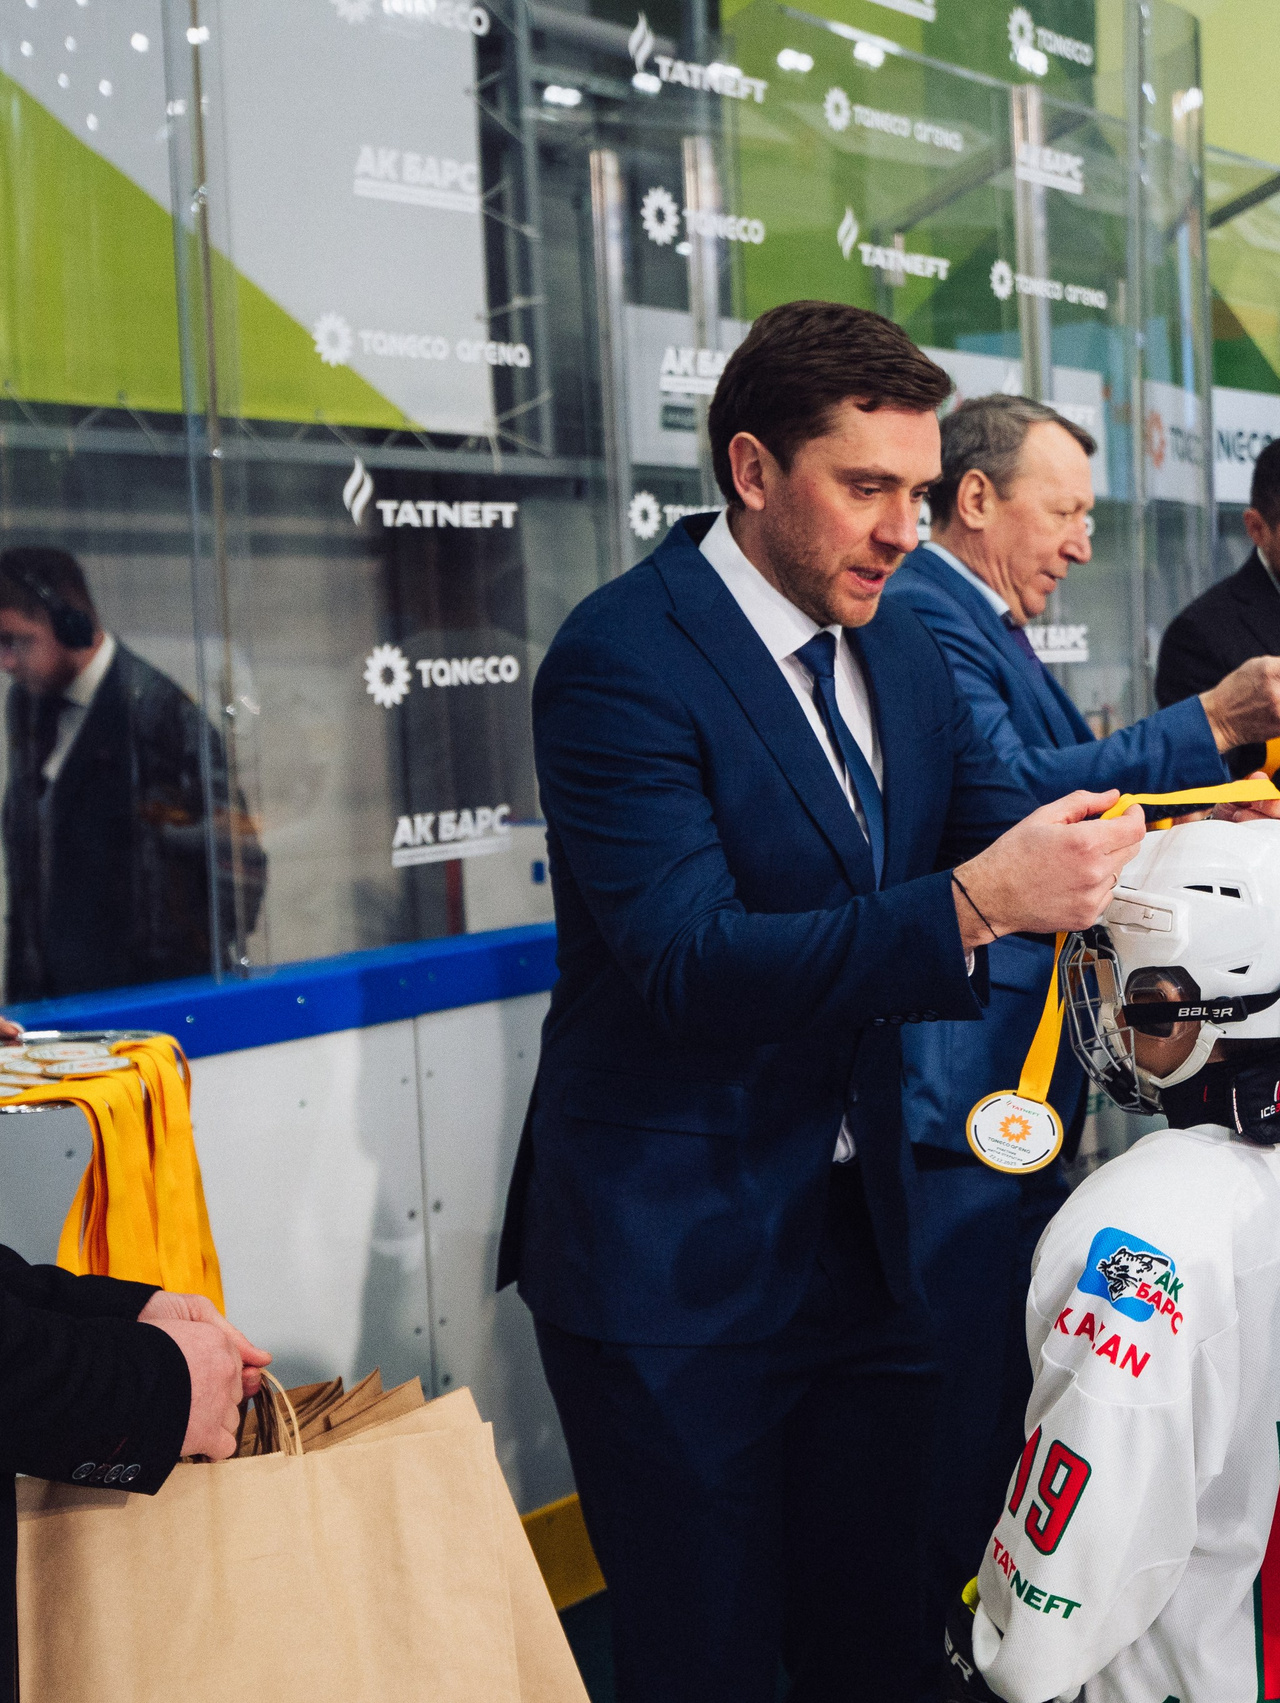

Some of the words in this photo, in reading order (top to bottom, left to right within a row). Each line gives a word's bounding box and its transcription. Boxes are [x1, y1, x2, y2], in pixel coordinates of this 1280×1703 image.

[656, 56, 768, 104] TATNEFT
[859, 242, 951, 280] TATNEFT
[376, 500, 518, 528] TATNEFT
[393, 813, 440, 849] АК
[438, 805, 511, 842] БАРС
[1012, 1104, 1040, 1117] TATNEFT
[1135, 1281, 1183, 1335] БАРС
[1154, 1271, 1184, 1303] АК
[1008, 1425, 1092, 1556] 19
[993, 1537, 1081, 1619] TATNEFT
